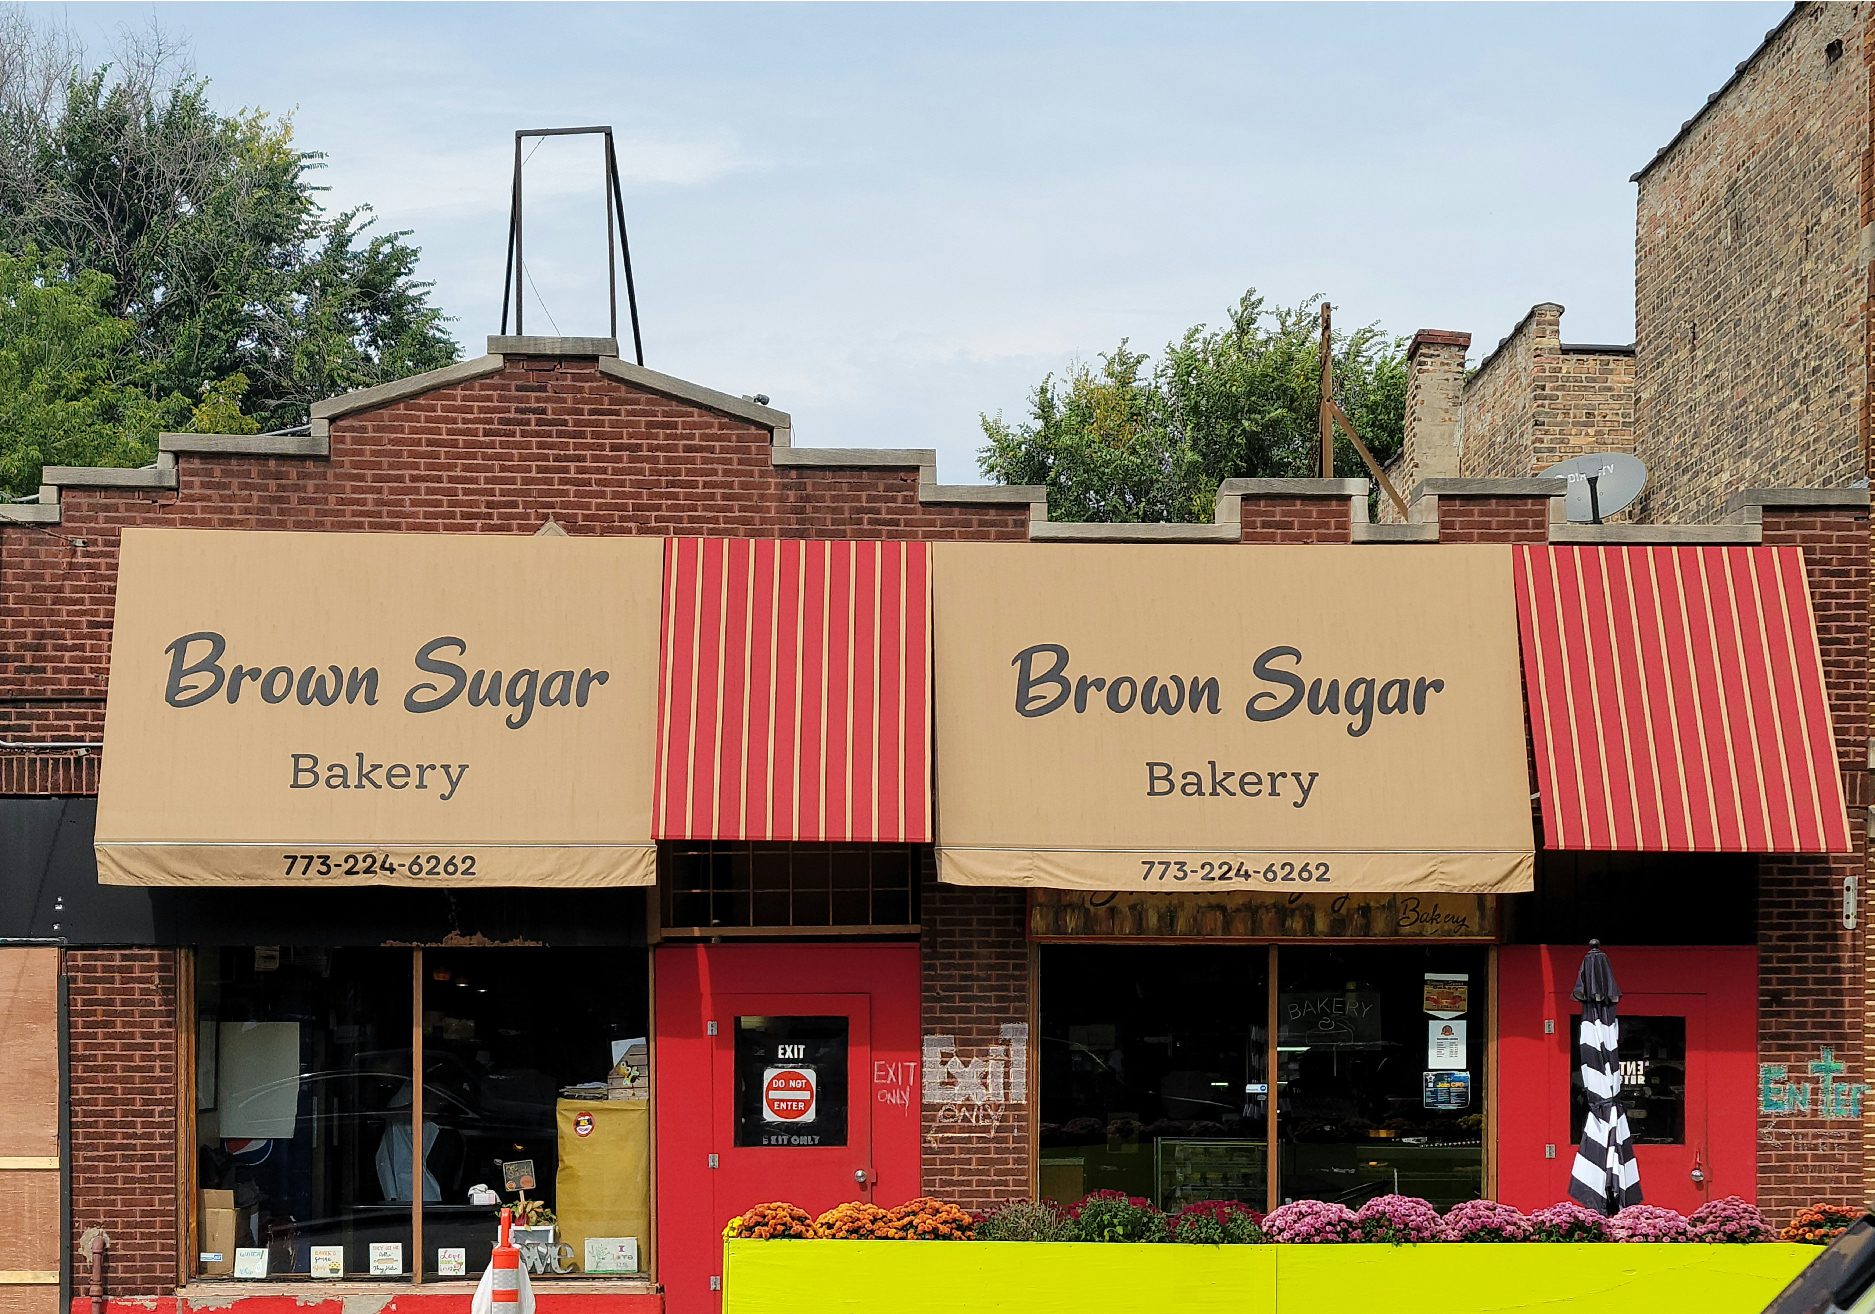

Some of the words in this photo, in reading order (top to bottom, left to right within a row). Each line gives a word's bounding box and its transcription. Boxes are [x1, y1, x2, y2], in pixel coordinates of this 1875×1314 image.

[165, 631, 379, 708] Brown
[403, 636, 609, 730] Sugar
[1011, 643, 1221, 718] Brown
[1246, 645, 1444, 738] Sugar
[290, 753, 469, 801] Bakery
[1146, 761, 1319, 808] Bakery
[283, 855, 477, 877] 773-224-6262
[1141, 861, 1331, 883] 773-224-6262
[1398, 897, 1469, 933] Bakery
[1288, 997, 1373, 1020] BAKERY
[777, 1044, 806, 1059] EXIT
[772, 1080, 786, 1088] DO
[789, 1080, 807, 1088] NOT
[874, 1061, 918, 1086] EXIT
[774, 1101, 805, 1110] ENTER
[877, 1086, 910, 1117] ONLY
[762, 1135, 788, 1145] EXIT
[790, 1135, 820, 1145] ONLY
